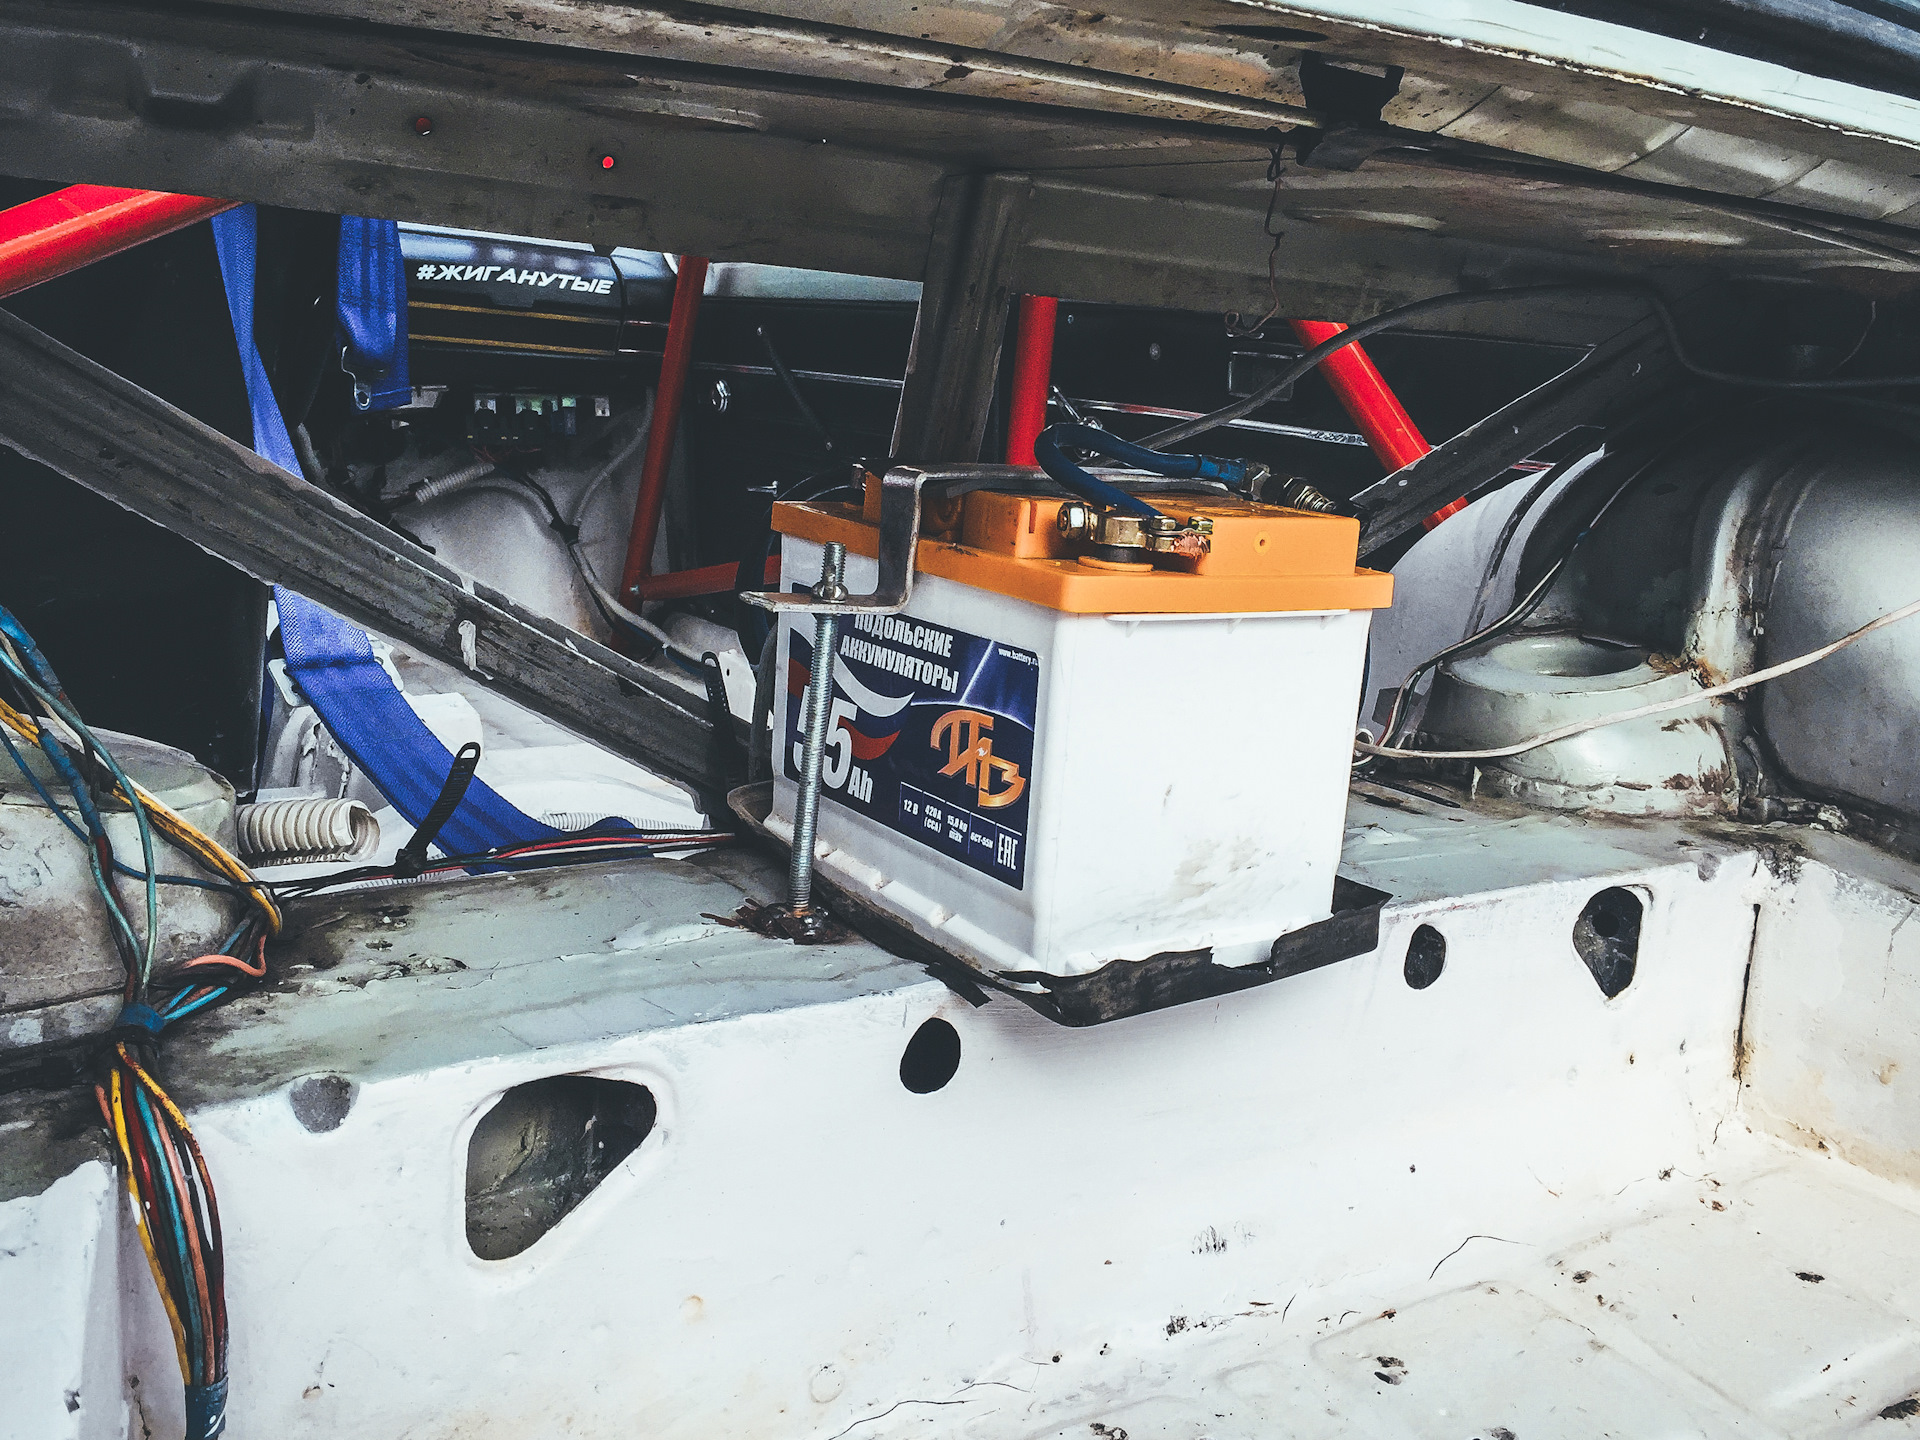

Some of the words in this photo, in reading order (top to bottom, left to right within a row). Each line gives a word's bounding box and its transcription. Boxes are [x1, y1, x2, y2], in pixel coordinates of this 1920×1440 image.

[415, 263, 615, 295] #ЖИГАНУТЫЕ
[854, 613, 954, 658] ПОДОЛЬСКИЕ
[839, 634, 960, 694] АККУМУЛЯТОРЫ
[904, 799, 912, 812] 12
[997, 832, 1018, 870] EAC
